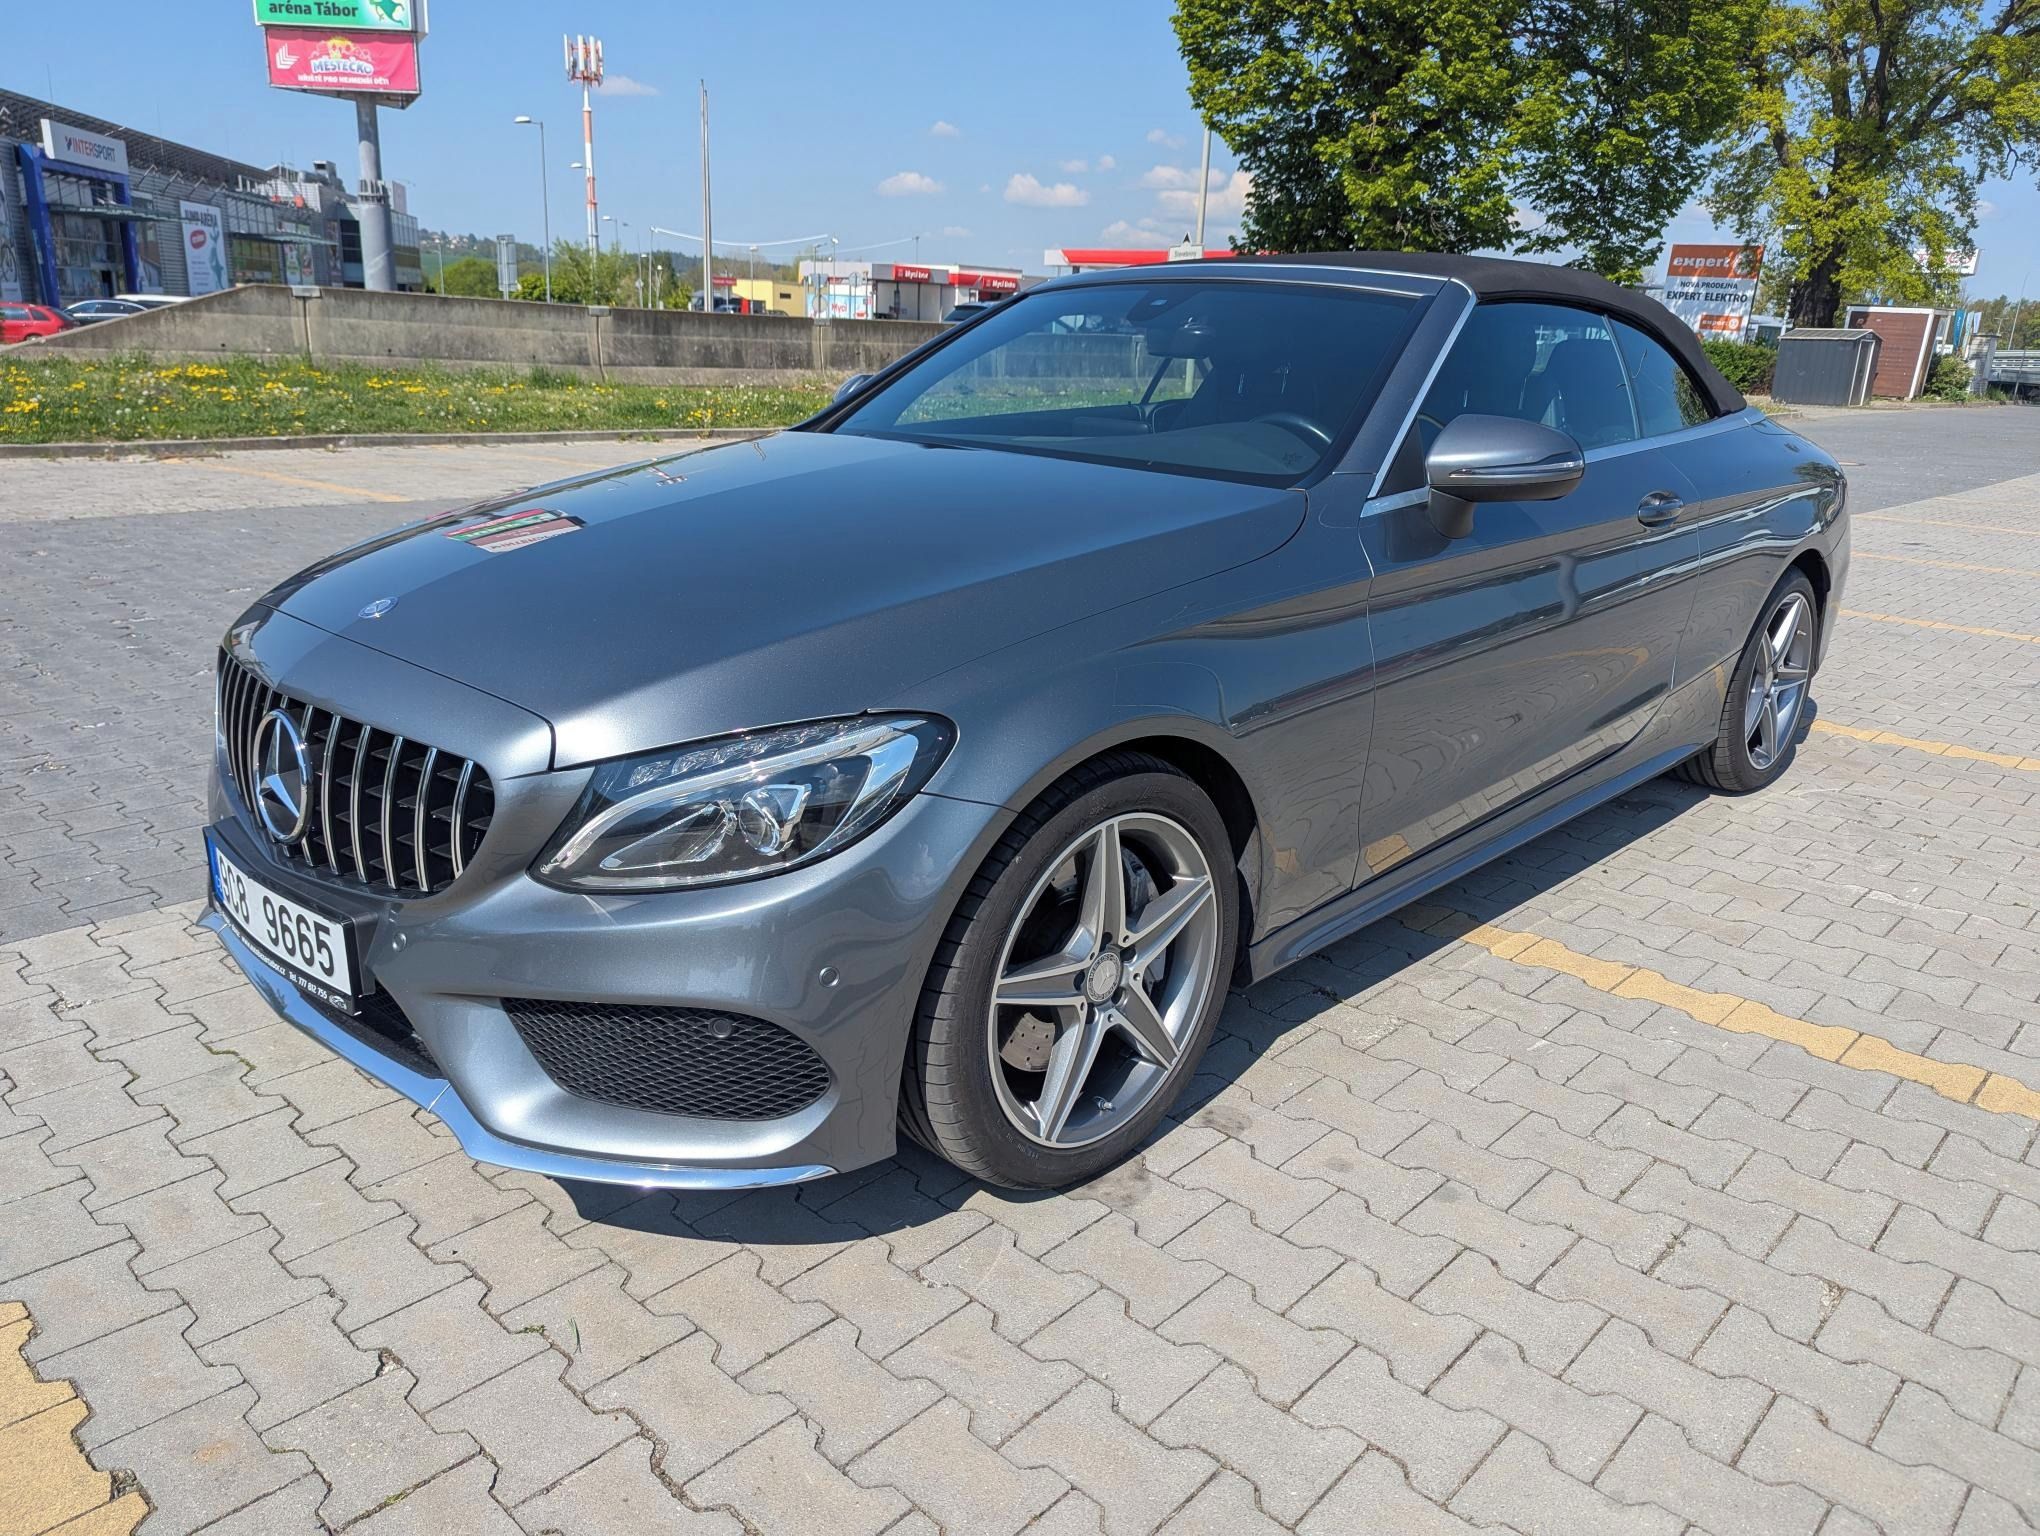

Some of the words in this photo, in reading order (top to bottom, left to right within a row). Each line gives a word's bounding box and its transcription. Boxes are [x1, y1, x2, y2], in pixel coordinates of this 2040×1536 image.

[269, 1, 312, 15] aréna
[314, 2, 359, 17] Tábor
[72, 136, 116, 162] INTERSPORT
[1673, 256, 1730, 269] expert
[1680, 280, 1700, 289] NOVÁ
[1701, 281, 1738, 290] PRODEJNA
[1666, 291, 1703, 301] EXPERT
[1704, 292, 1748, 303] ELEKTRO
[219, 855, 250, 925] 9C8
[262, 895, 335, 977] 9665
